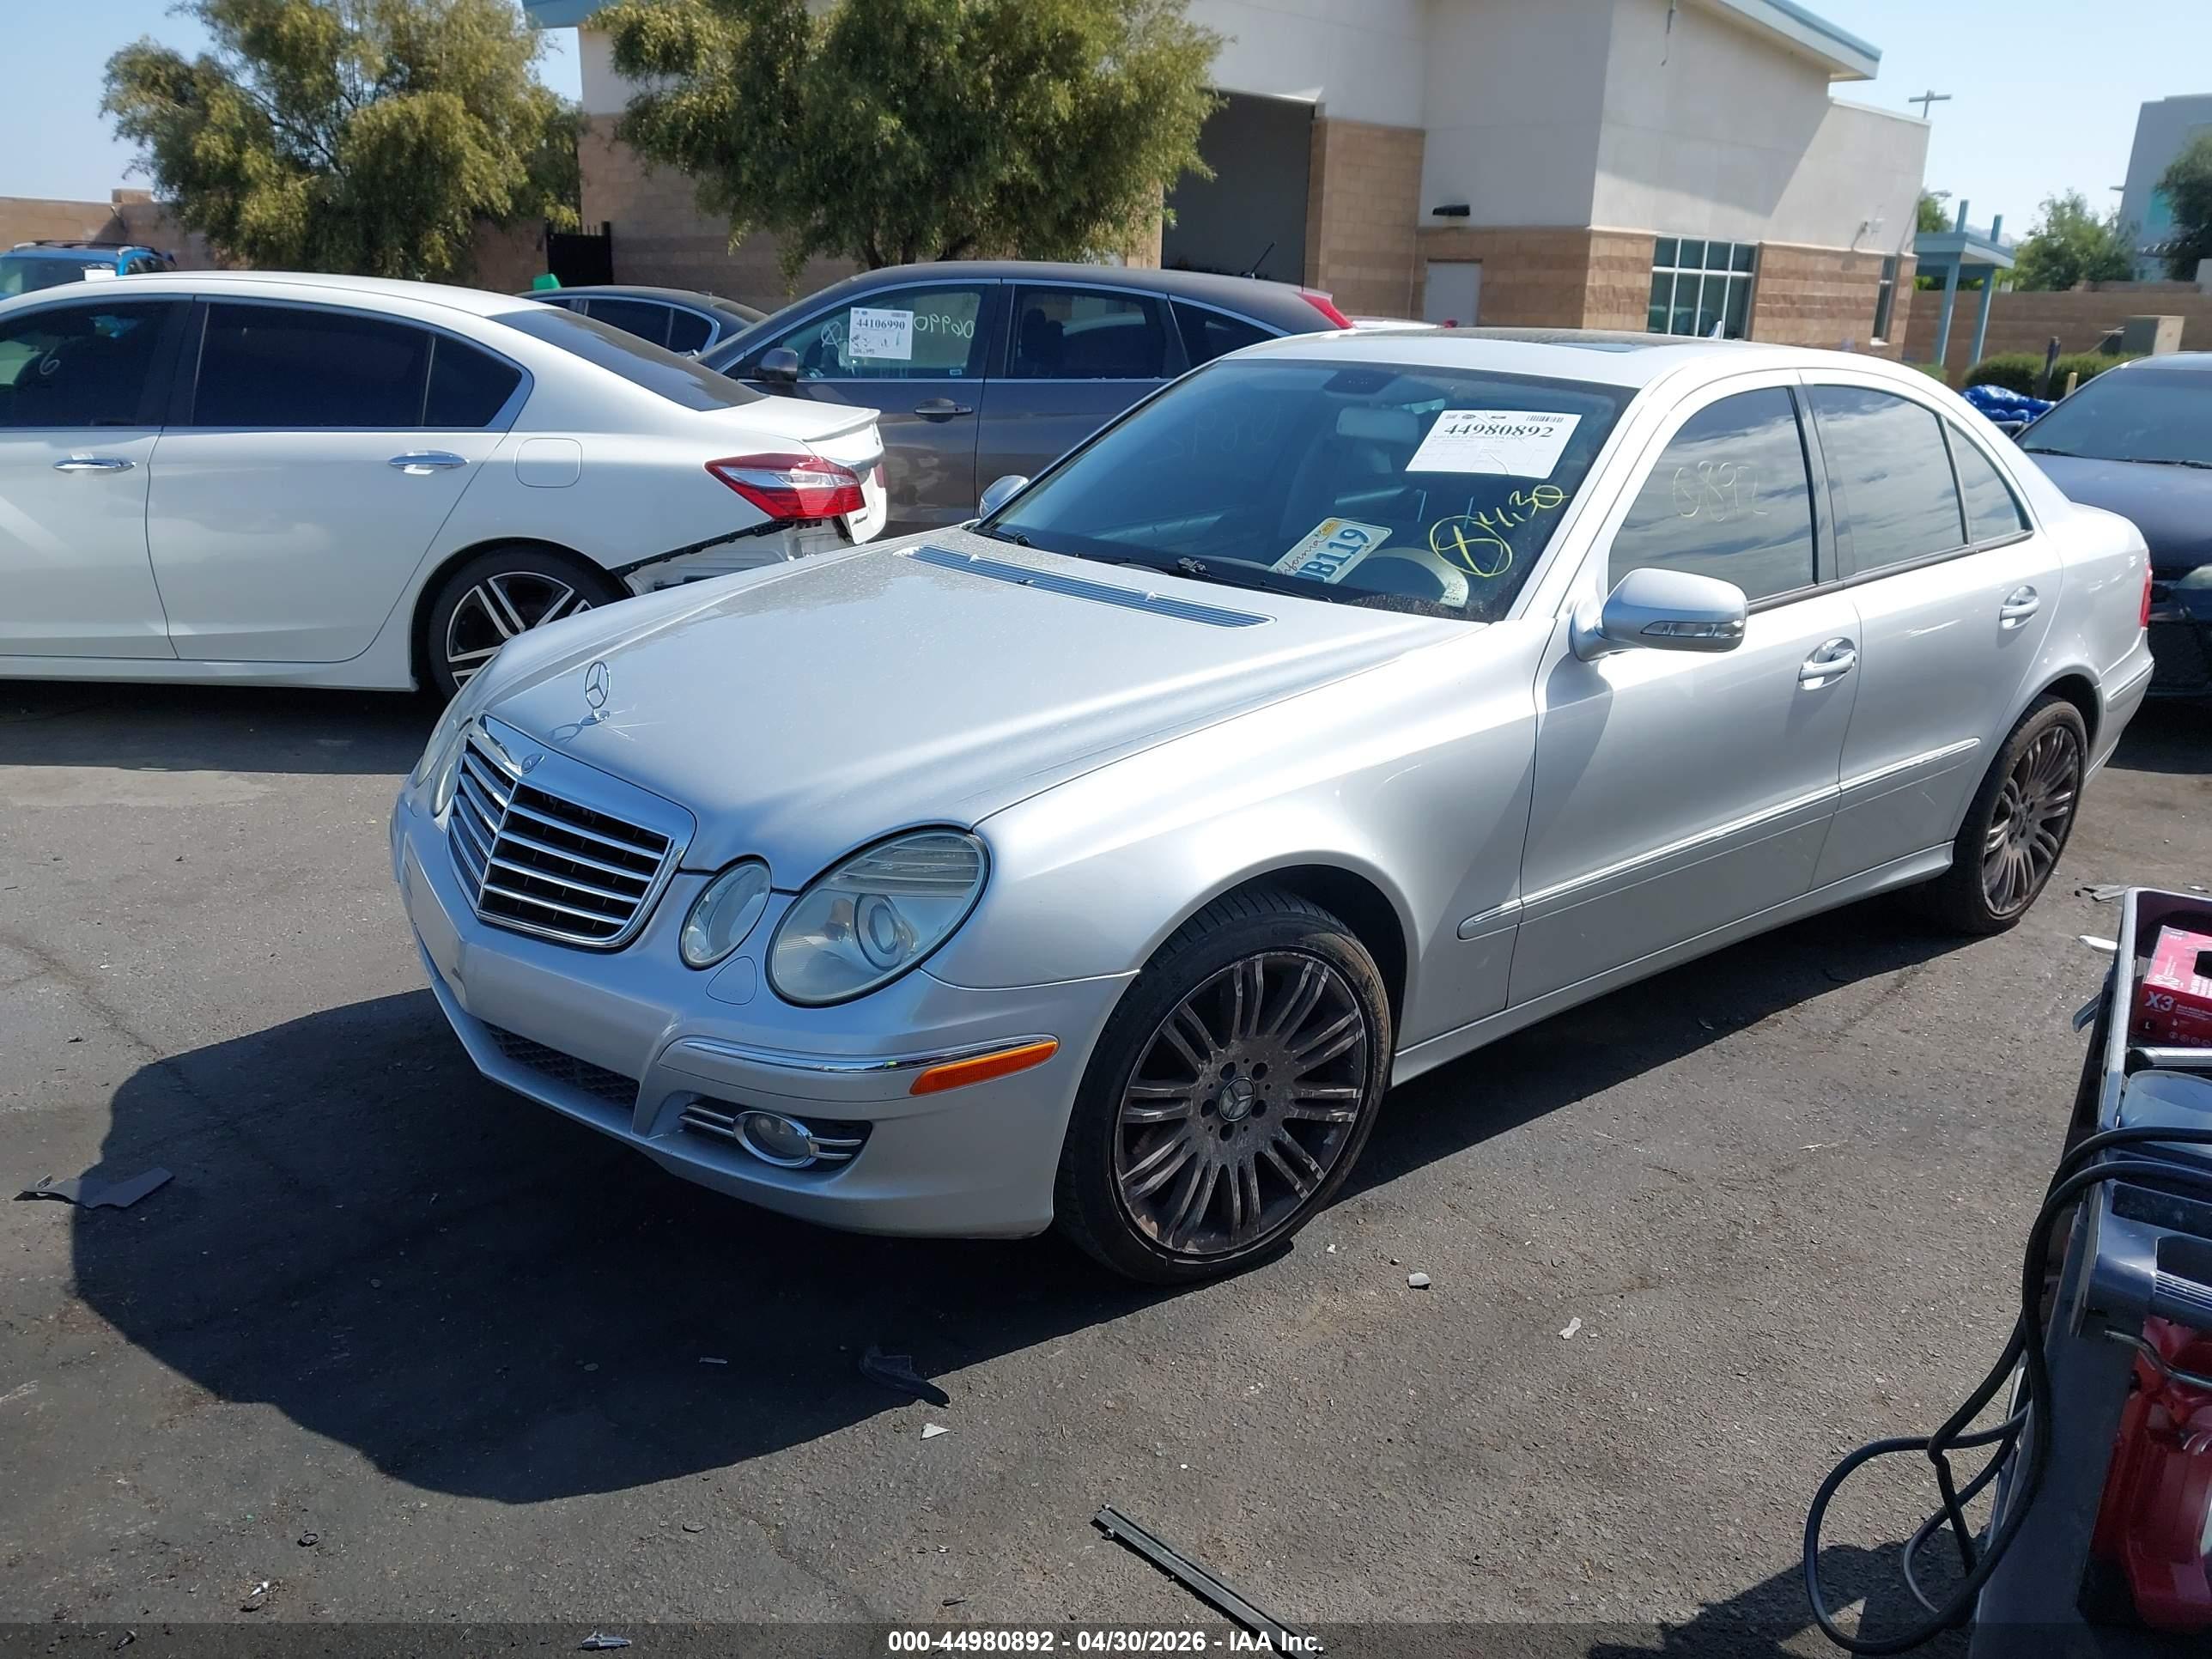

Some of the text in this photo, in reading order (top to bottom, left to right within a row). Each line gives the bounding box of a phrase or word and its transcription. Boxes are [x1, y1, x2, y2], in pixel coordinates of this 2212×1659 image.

[857, 318, 905, 331] 44106990
[1444, 423, 1554, 438] 44980892
[2145, 990, 2175, 1012] X3
